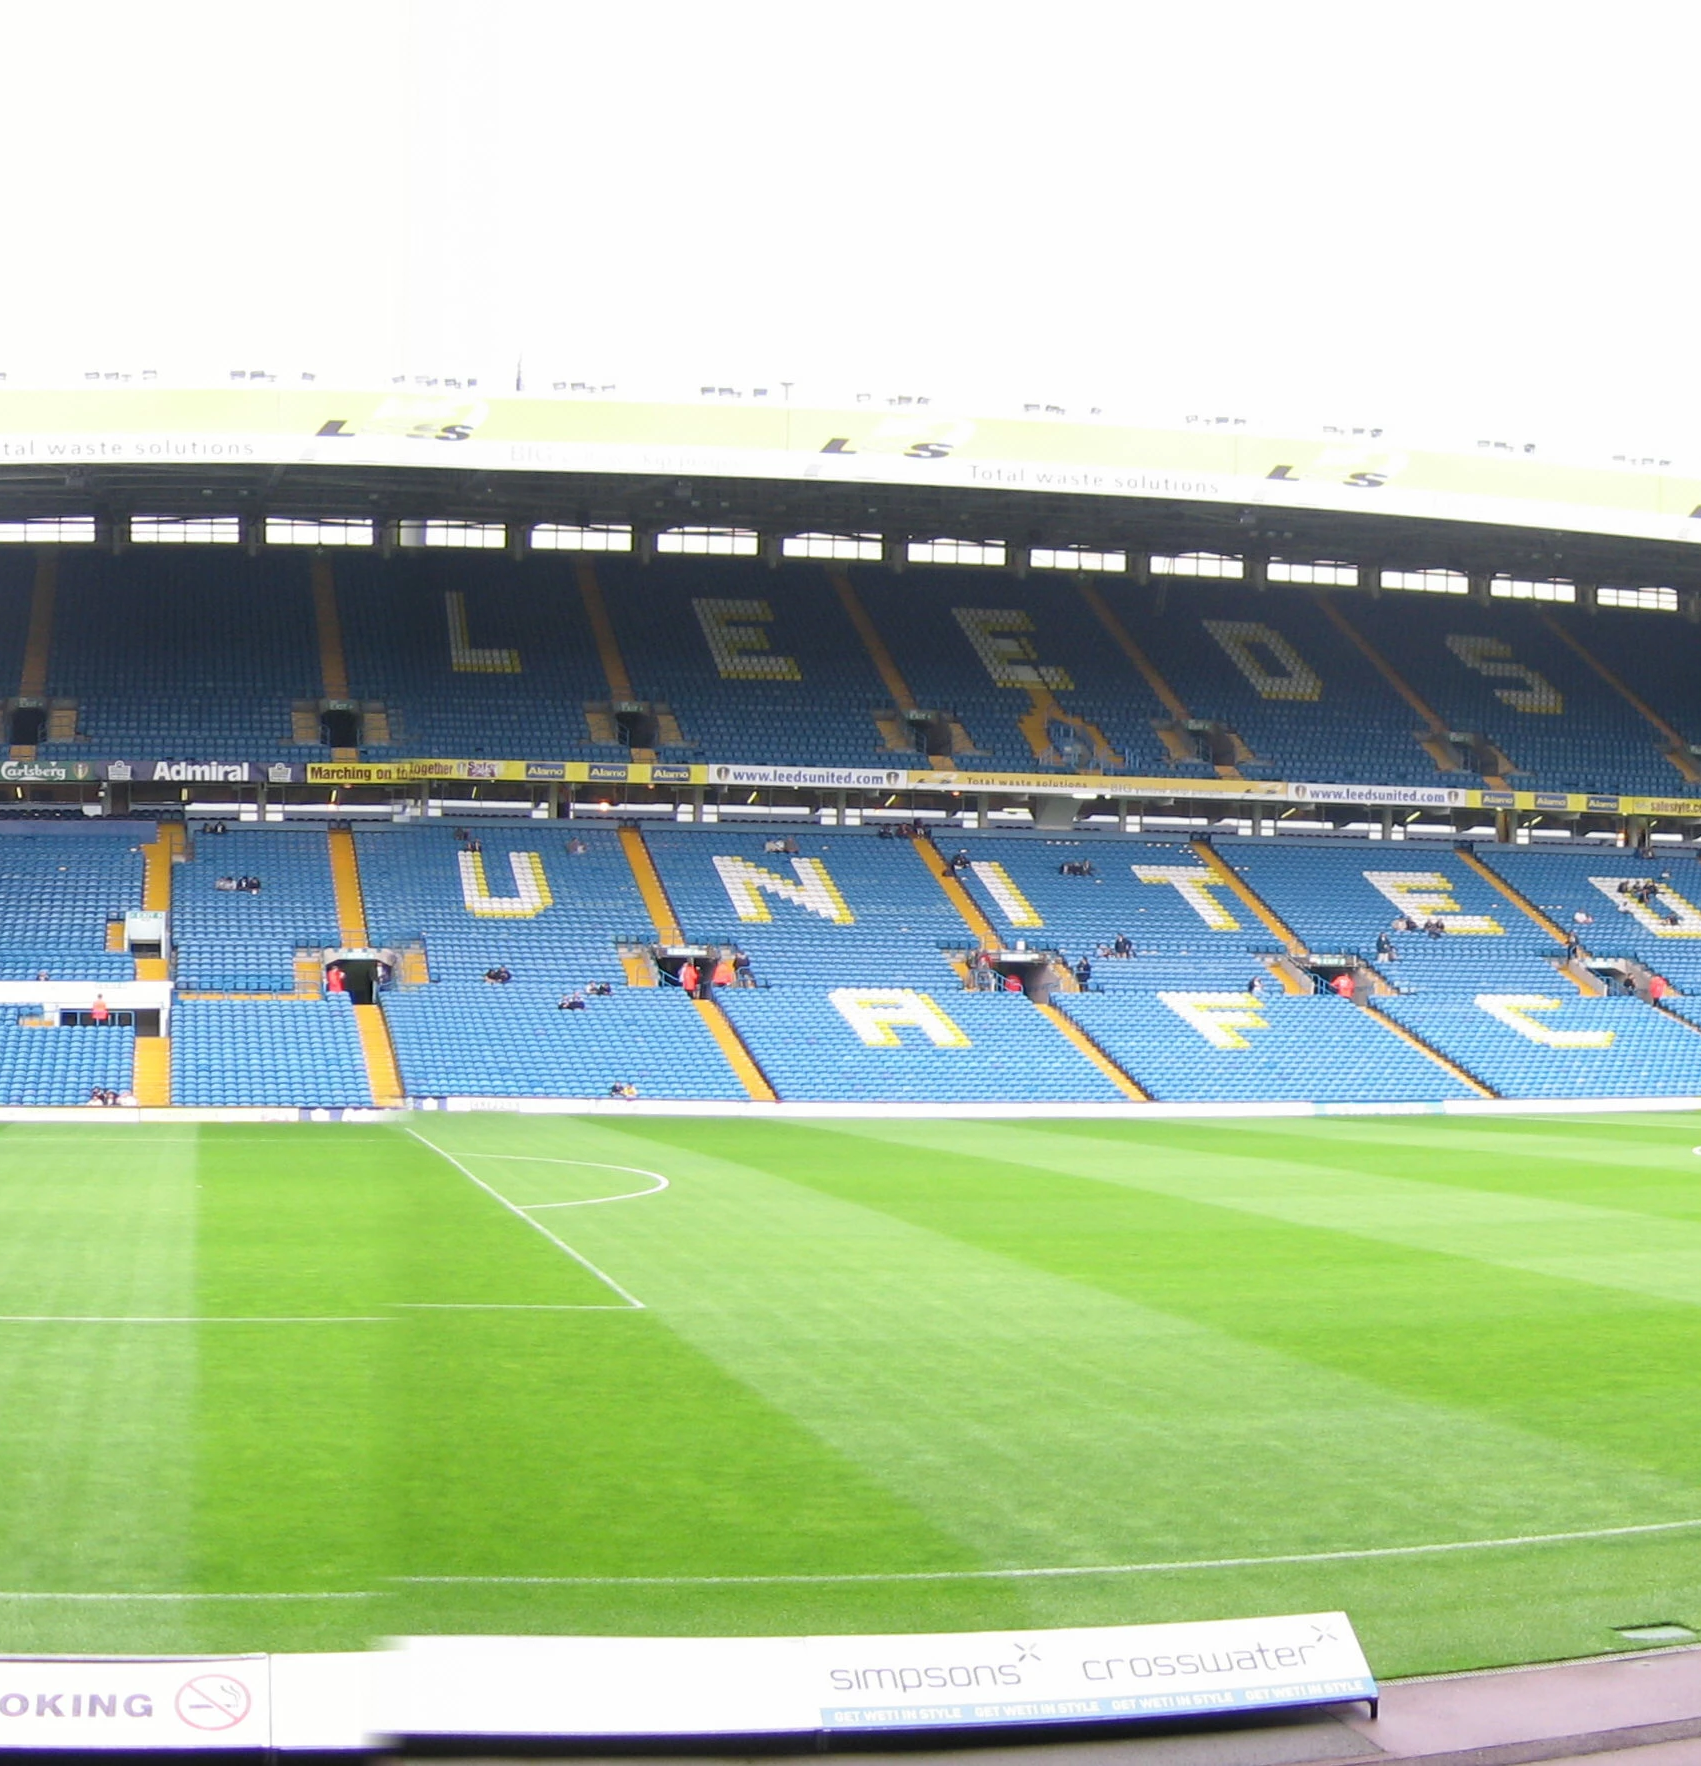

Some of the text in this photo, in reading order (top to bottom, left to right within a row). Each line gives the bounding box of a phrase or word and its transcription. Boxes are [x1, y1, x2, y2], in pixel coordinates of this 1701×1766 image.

[46, 441, 122, 457] waste
[135, 440, 255, 457] solutions
[970, 463, 1220, 495] Total waste solutions
[1, 761, 67, 781] Carlsberg
[152, 761, 249, 782] Admiral
[309, 766, 372, 781] Marching
[376, 769, 393, 780] on
[527, 766, 564, 777] Alamo
[590, 767, 627, 778] Alamo
[653, 769, 689, 780] Alamo
[733, 769, 884, 786] www.leedsunited.com
[966, 777, 1089, 789] Total waste solutions
[1309, 788, 1446, 804] www.leedsunited.com
[1482, 795, 1514, 806] Alamo
[1535, 797, 1567, 807] Alamo
[1588, 799, 1618, 810] Alamo
[829, 1641, 1318, 1693] simpsons crosswater
[1245, 1688, 1270, 1702] GET
[1309, 1683, 1323, 1696] IN
[1324, 1679, 1364, 1695] STYLE
[974, 1705, 1000, 1718] GET
[1041, 1703, 1056, 1715] IN
[1057, 1700, 1101, 1715] STYLE
[1111, 1696, 1138, 1711] GET
[1176, 1694, 1191, 1707] IN
[1193, 1691, 1235, 1706] STYLE
[833, 1709, 860, 1723] GET
[902, 1709, 917, 1721] IN
[919, 1707, 962, 1721] STYLE
